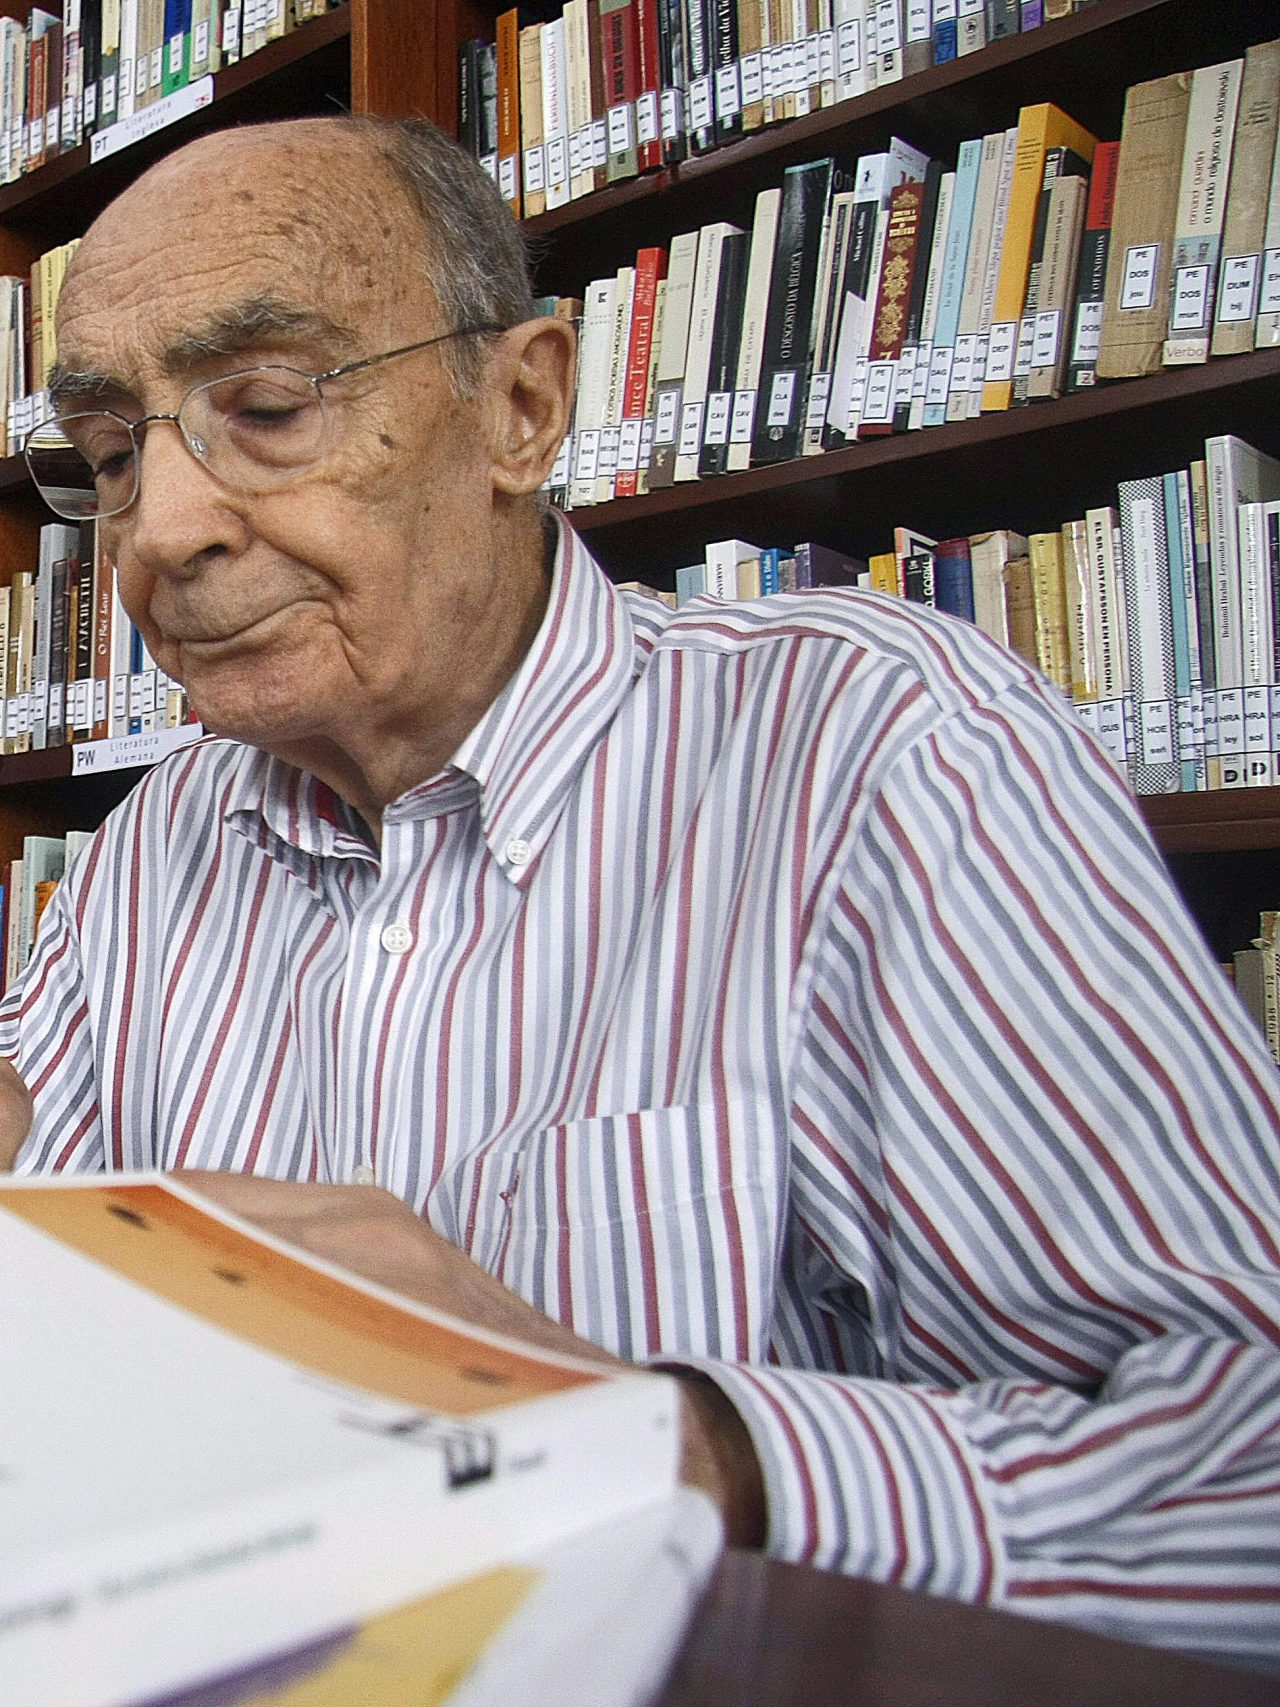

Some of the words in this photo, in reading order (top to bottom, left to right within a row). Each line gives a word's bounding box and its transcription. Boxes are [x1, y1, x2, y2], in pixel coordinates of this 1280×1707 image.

[95, 136, 109, 153] PT
[1207, 141, 1221, 178] religioso
[1042, 160, 1058, 190] VOLUME
[1204, 182, 1215, 215] mundo
[1135, 251, 1148, 259] PE
[1234, 261, 1247, 269] PE
[1130, 270, 1149, 278] DOS
[1185, 270, 1199, 278] PE
[1227, 281, 1250, 290] DUM
[1128, 289, 1144, 298] jou
[1179, 290, 1200, 299] DOS
[1086, 305, 1099, 313] PE
[782, 303, 798, 349] DESGOSTO
[1081, 324, 1100, 332] DOS
[997, 327, 1009, 335] PE
[960, 337, 971, 346] PE
[629, 316, 651, 380] Teatral
[991, 345, 1009, 353] DEP
[1167, 346, 1204, 357] Verbo
[936, 350, 948, 358] PE
[1094, 521, 1102, 533] EL
[1217, 541, 1226, 577] Leyendas
[1097, 554, 1108, 623] GUSTAFSSON
[1101, 625, 1109, 639] EN
[1103, 641, 1113, 691] PERSONA
[1221, 692, 1235, 702] PE
[1247, 690, 1261, 699] PE
[1079, 707, 1092, 716] PE
[1102, 703, 1115, 712] PE
[1149, 705, 1162, 714] PE
[1219, 713, 1240, 723] HRA
[1244, 711, 1266, 720] HRA
[1100, 724, 1119, 733] GUS
[1146, 725, 1167, 734] HOE
[1248, 733, 1264, 742] sol
[110, 737, 159, 752] Literatura
[77, 750, 96, 767] PW
[114, 752, 155, 764] Alemana
